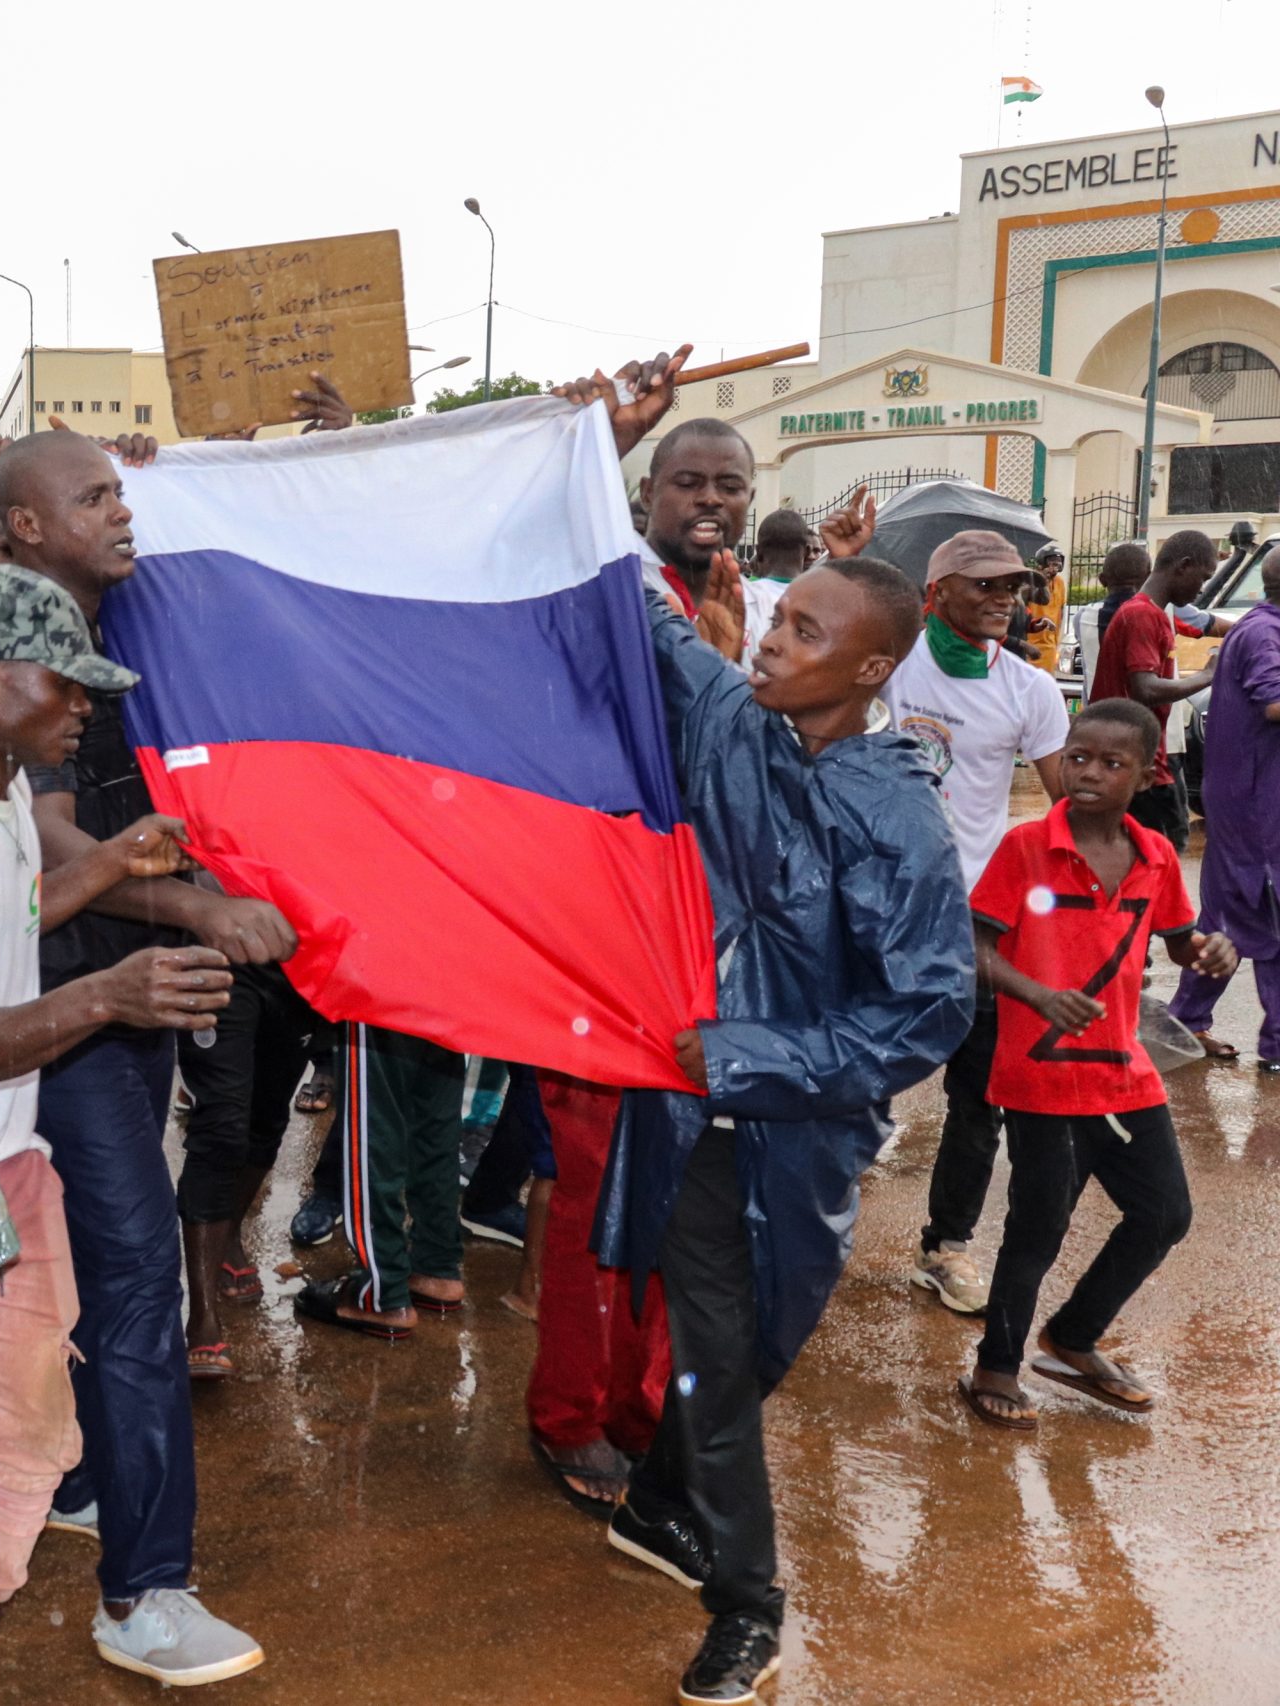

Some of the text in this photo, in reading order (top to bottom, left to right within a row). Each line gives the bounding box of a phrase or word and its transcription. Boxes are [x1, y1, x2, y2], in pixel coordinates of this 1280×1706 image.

[979, 130, 1280, 202] ASSEMBLEE N
[780, 411, 865, 435] FRATERNITE
[887, 406, 946, 427] TRAVAIL
[966, 400, 1038, 423] PROGRES
[1026, 893, 1150, 1063] Z
